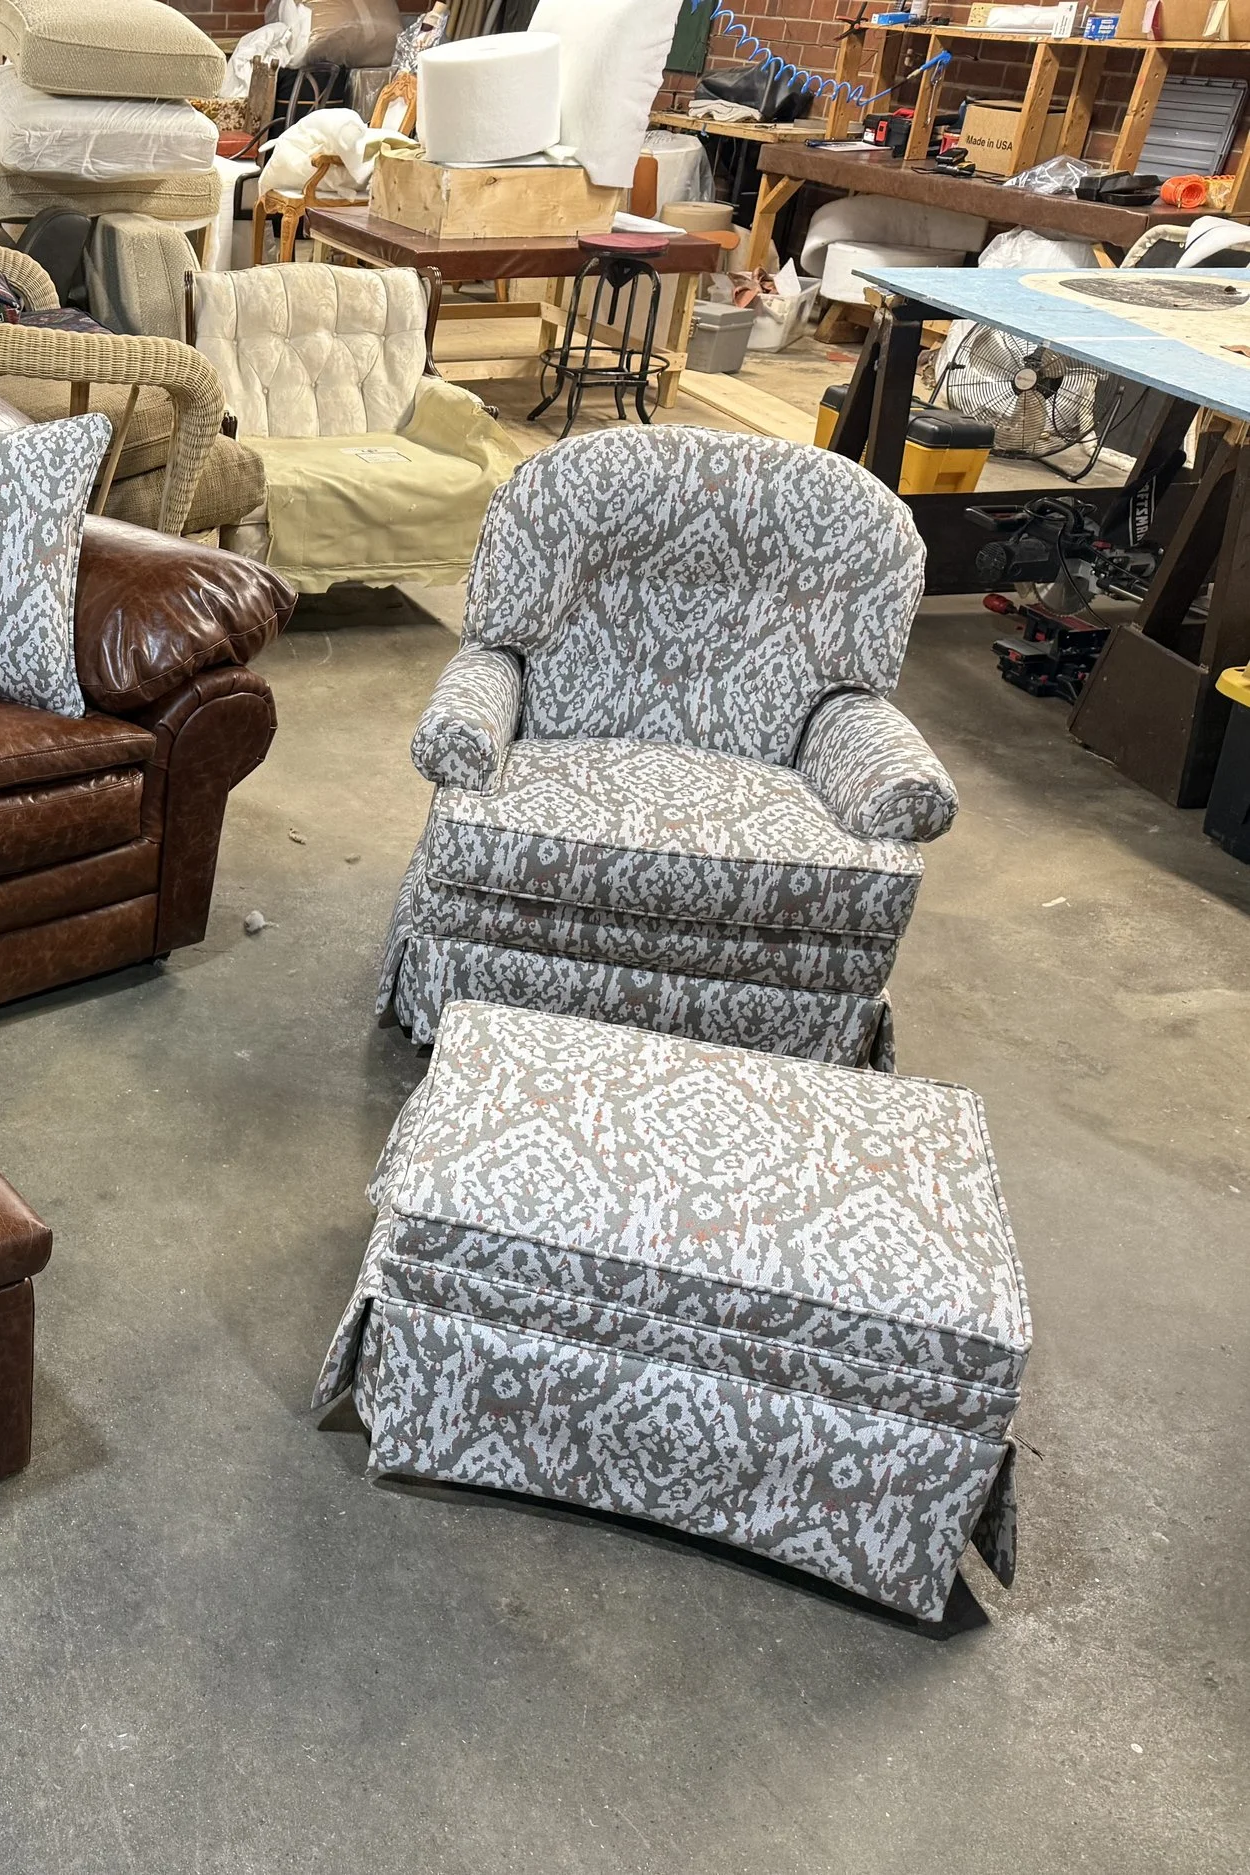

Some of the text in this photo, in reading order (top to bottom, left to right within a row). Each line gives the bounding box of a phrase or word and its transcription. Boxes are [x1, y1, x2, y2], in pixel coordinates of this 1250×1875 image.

[966, 135, 1013, 151] Made in USA
